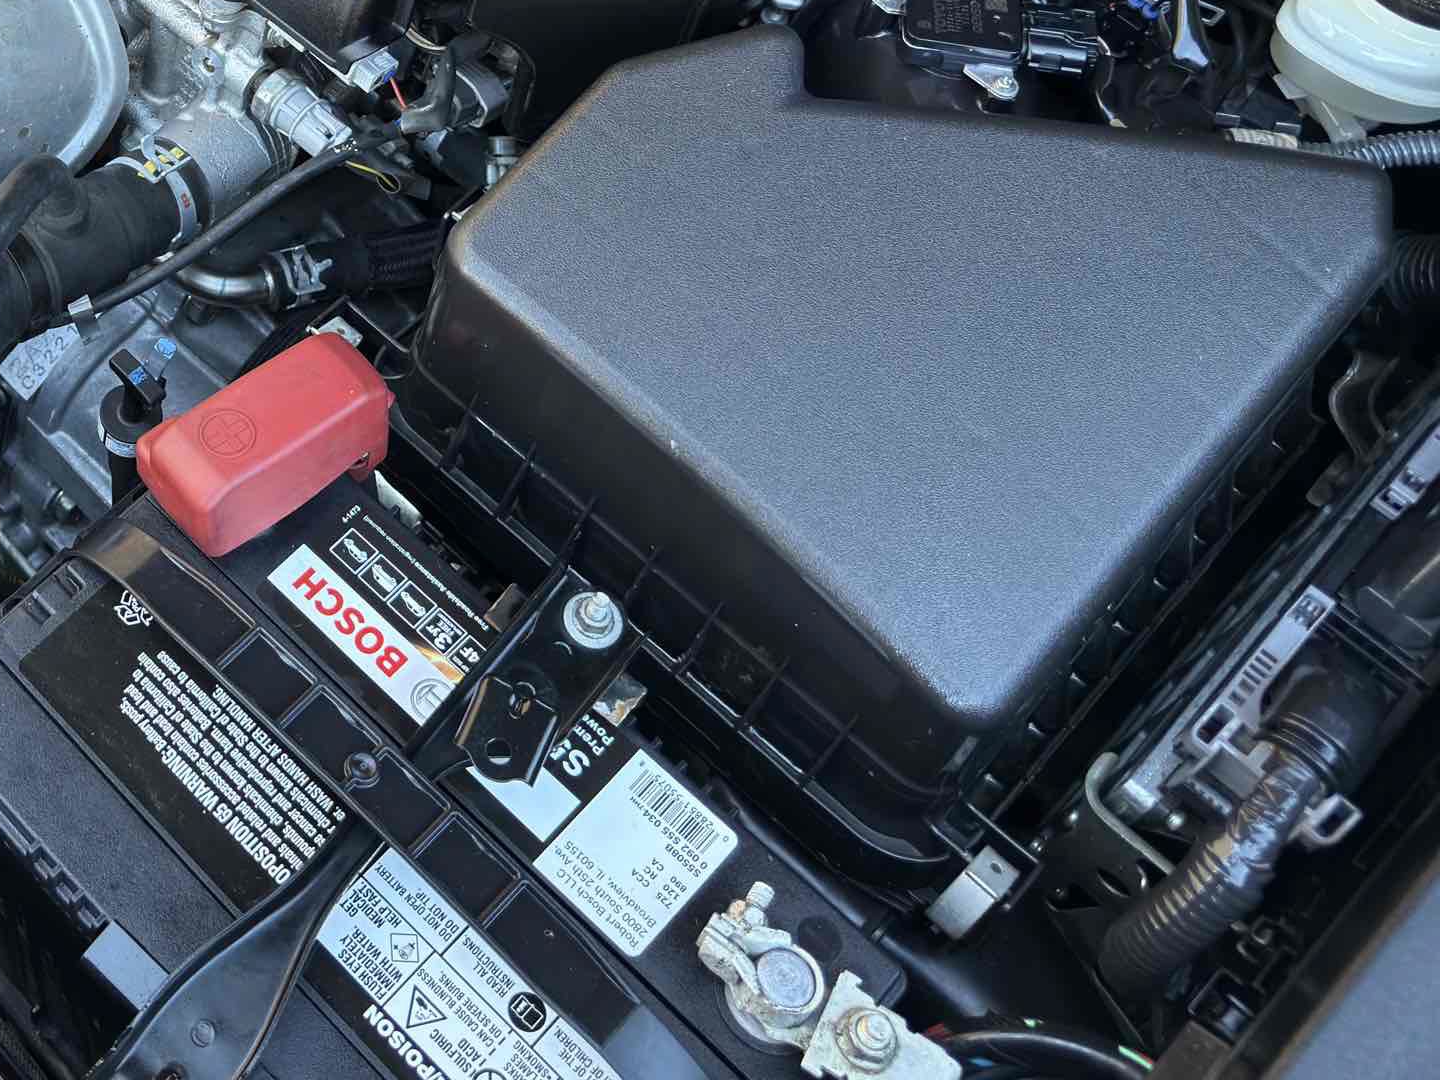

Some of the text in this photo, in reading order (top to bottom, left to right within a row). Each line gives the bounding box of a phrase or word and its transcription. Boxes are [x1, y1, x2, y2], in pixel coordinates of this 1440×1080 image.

[414, 561, 447, 591] Assistance
[290, 563, 410, 680] BOSCH
[137, 651, 166, 681] contain
[161, 677, 181, 697] also
[177, 693, 212, 730] Batteries
[212, 684, 256, 732] HANDLING.
[156, 650, 330, 828] chemicals known to the State of California to cause
[210, 724, 233, 753] harm.
[251, 727, 281, 757] AFTER
[572, 724, 604, 755] Prem
[581, 714, 614, 745] Powe
[123, 683, 303, 870] inals and related accessories contain lead and lead
[132, 668, 315, 859] pounds, chemicals known to the State of California to
[229, 747, 277, 797] reproductive
[276, 753, 309, 786] HANDS
[119, 696, 290, 884] OPOSITION 65 WARNING: Battery posts,
[271, 792, 291, 811] and
[304, 781, 333, 811] WASH
[287, 808, 316, 837] cancer
[642, 809, 661, 827] 034
[680, 843, 699, 862] 092
[699, 861, 707, 869] 0
[554, 845, 648, 938] 2800 South 25th Ave.
[563, 840, 656, 928] Broadview, IL 60155
[631, 868, 672, 909] 725 CCA
[643, 865, 679, 900] 120 RC
[651, 857, 687, 892] 890 CA
[339, 898, 358, 917] GET
[348, 888, 385, 928] MEDICAL
[357, 881, 401, 928] HELP FAST.
[404, 893, 425, 915] OPEN
[415, 888, 459, 934] DO NOT TIP.
[422, 912, 441, 930] NOT
[556, 868, 639, 948] Robert Bosch LLC
[438, 927, 452, 941] DO
[339, 934, 397, 991] IMMEDIATELY
[351, 925, 402, 982] WITH WATER.
[462, 934, 515, 990] INSTRUCTIONS.
[337, 948, 387, 1000] FLUSH EYES
[472, 960, 508, 998] READ ALL
[416, 968, 494, 1047] CAN CAUSE BLINDNESS
[438, 970, 502, 1038] OR SEVERE BURNS.
[358, 1002, 448, 1080] /POISON
[429, 1028, 472, 1072] SULFURIC
[457, 1038, 481, 1062] ACID
[553, 1025, 603, 1080] OF CHILDREN.
[508, 1052, 539, 1080] LAMES
[557, 1047, 586, 1077] OF THE
